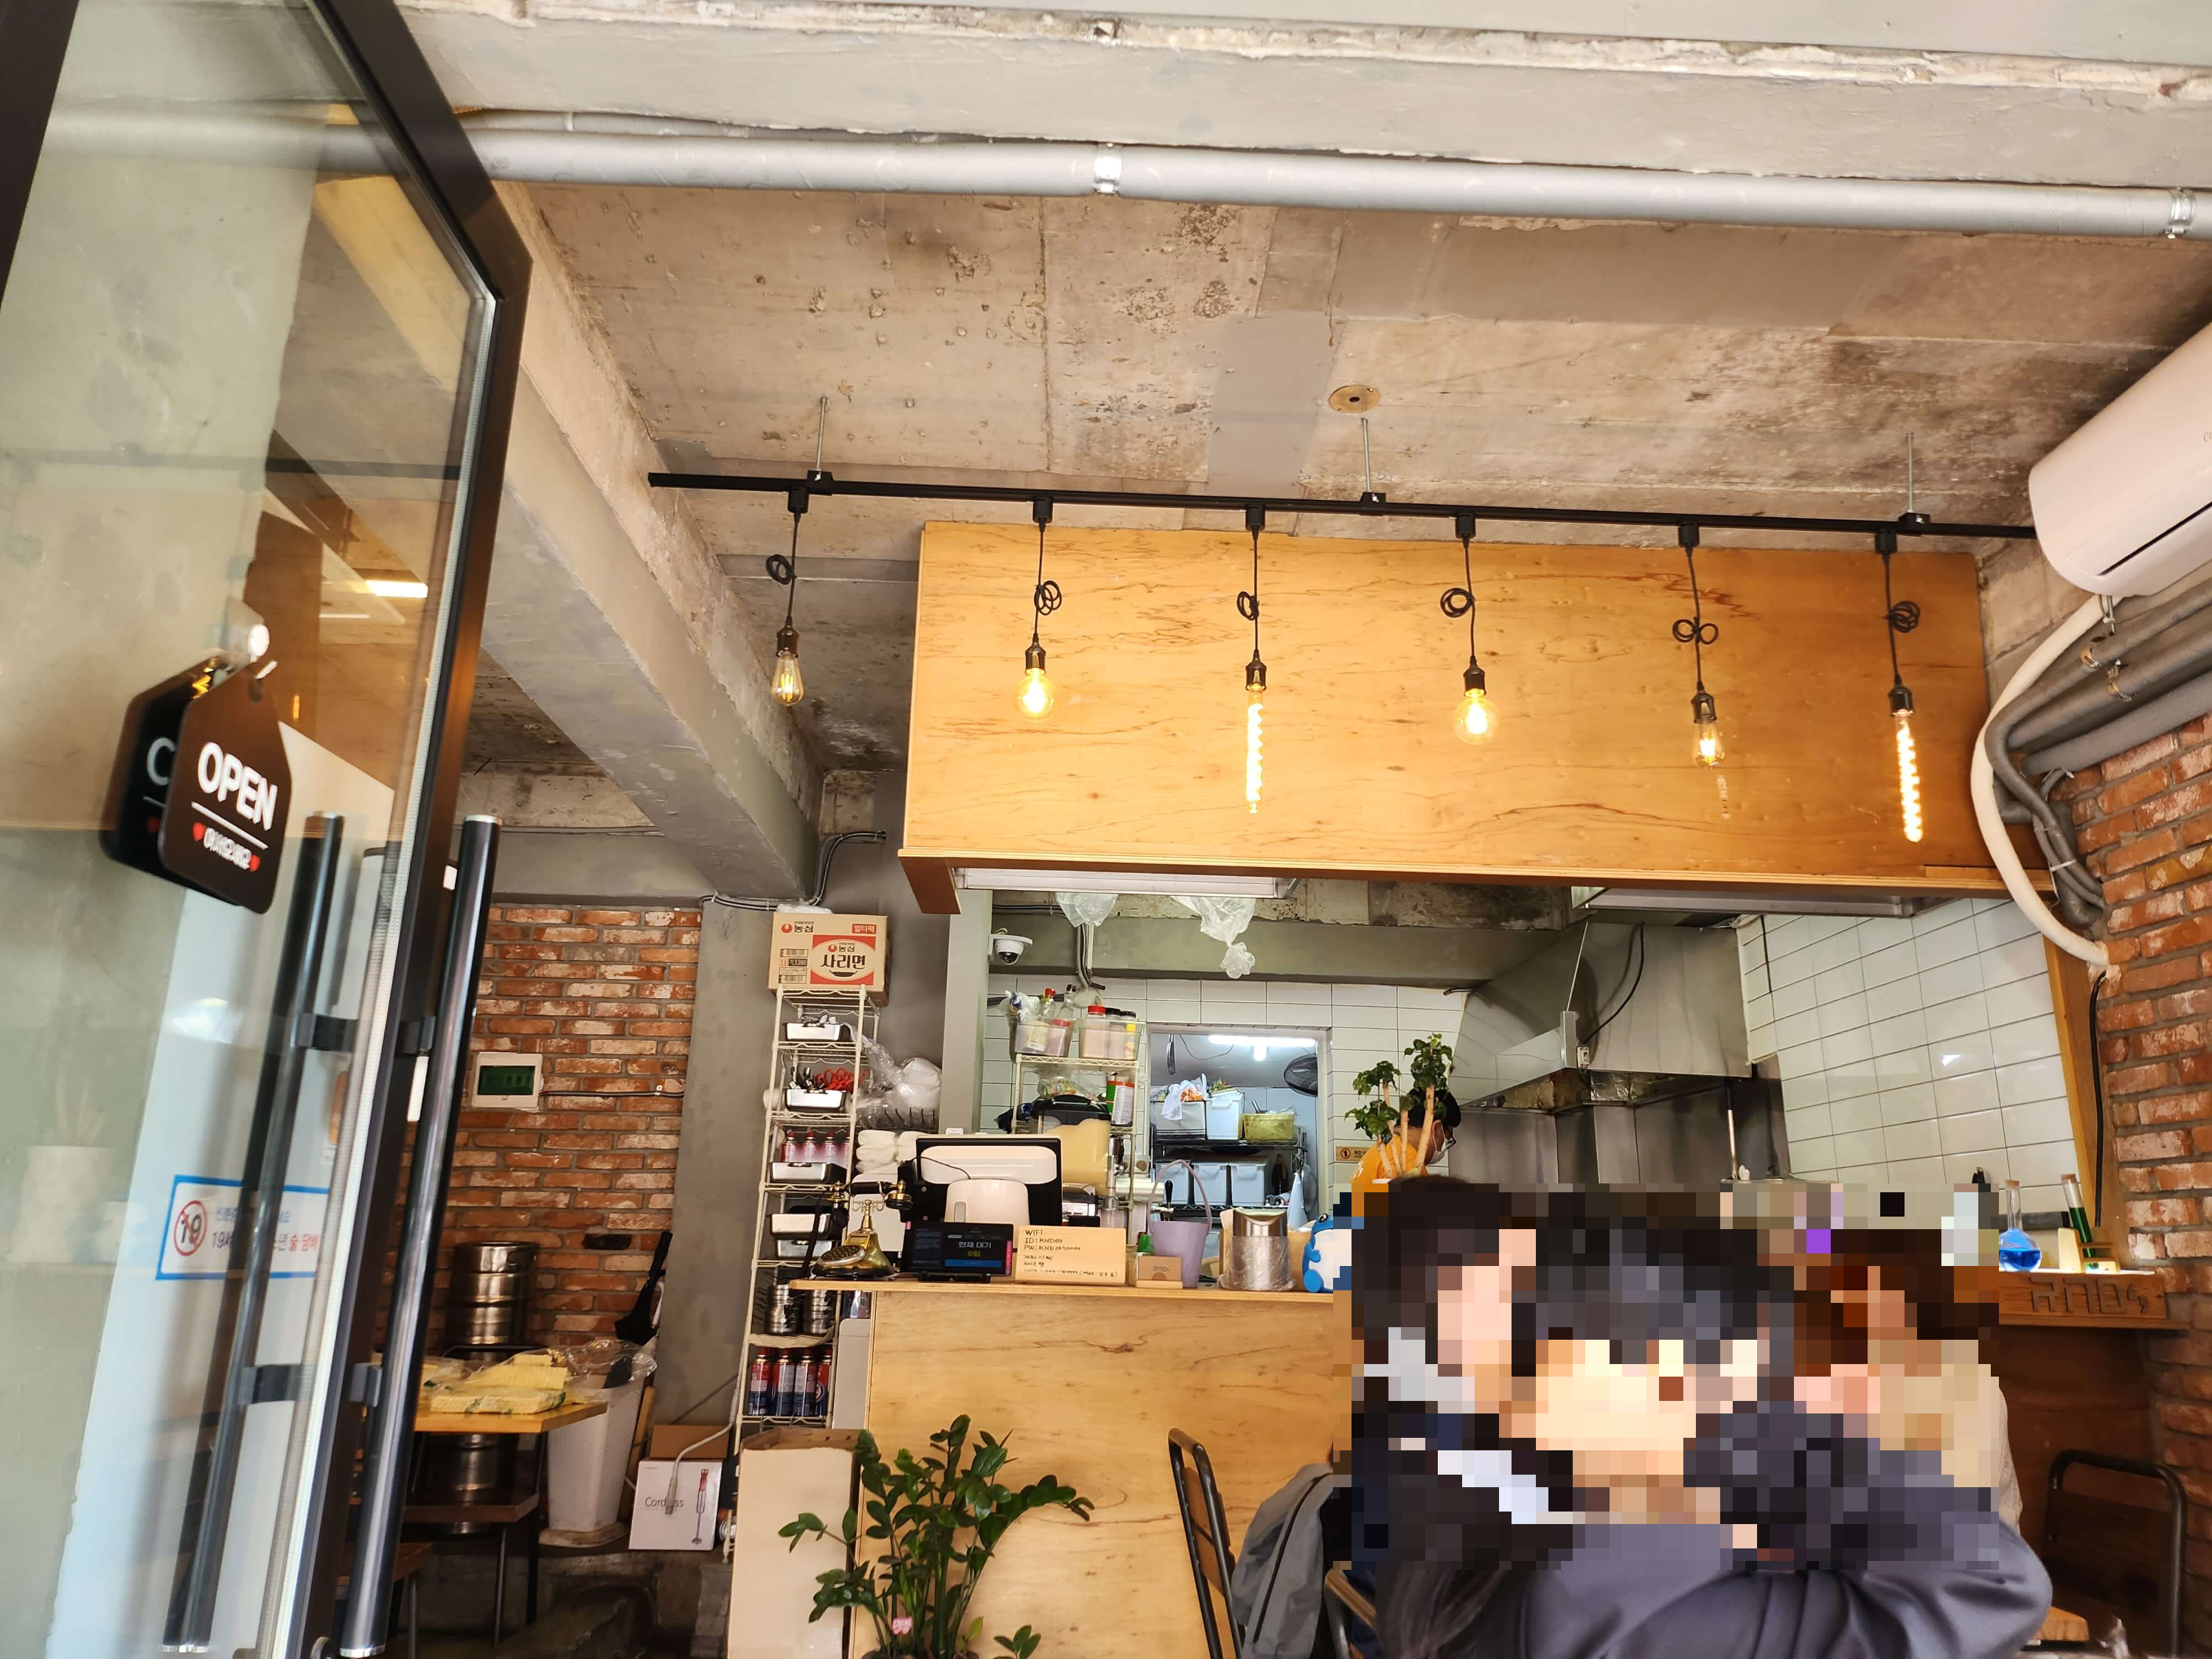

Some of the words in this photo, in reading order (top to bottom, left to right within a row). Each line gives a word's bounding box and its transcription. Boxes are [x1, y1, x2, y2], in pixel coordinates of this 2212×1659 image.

[198, 742, 278, 832] OPEN
[794, 925, 813, 933] 농심
[853, 924, 876, 933] 멀티팩
[838, 945, 855, 953] 농심
[821, 954, 866, 970] 사리면
[644, 1496, 684, 1508] Cordss
